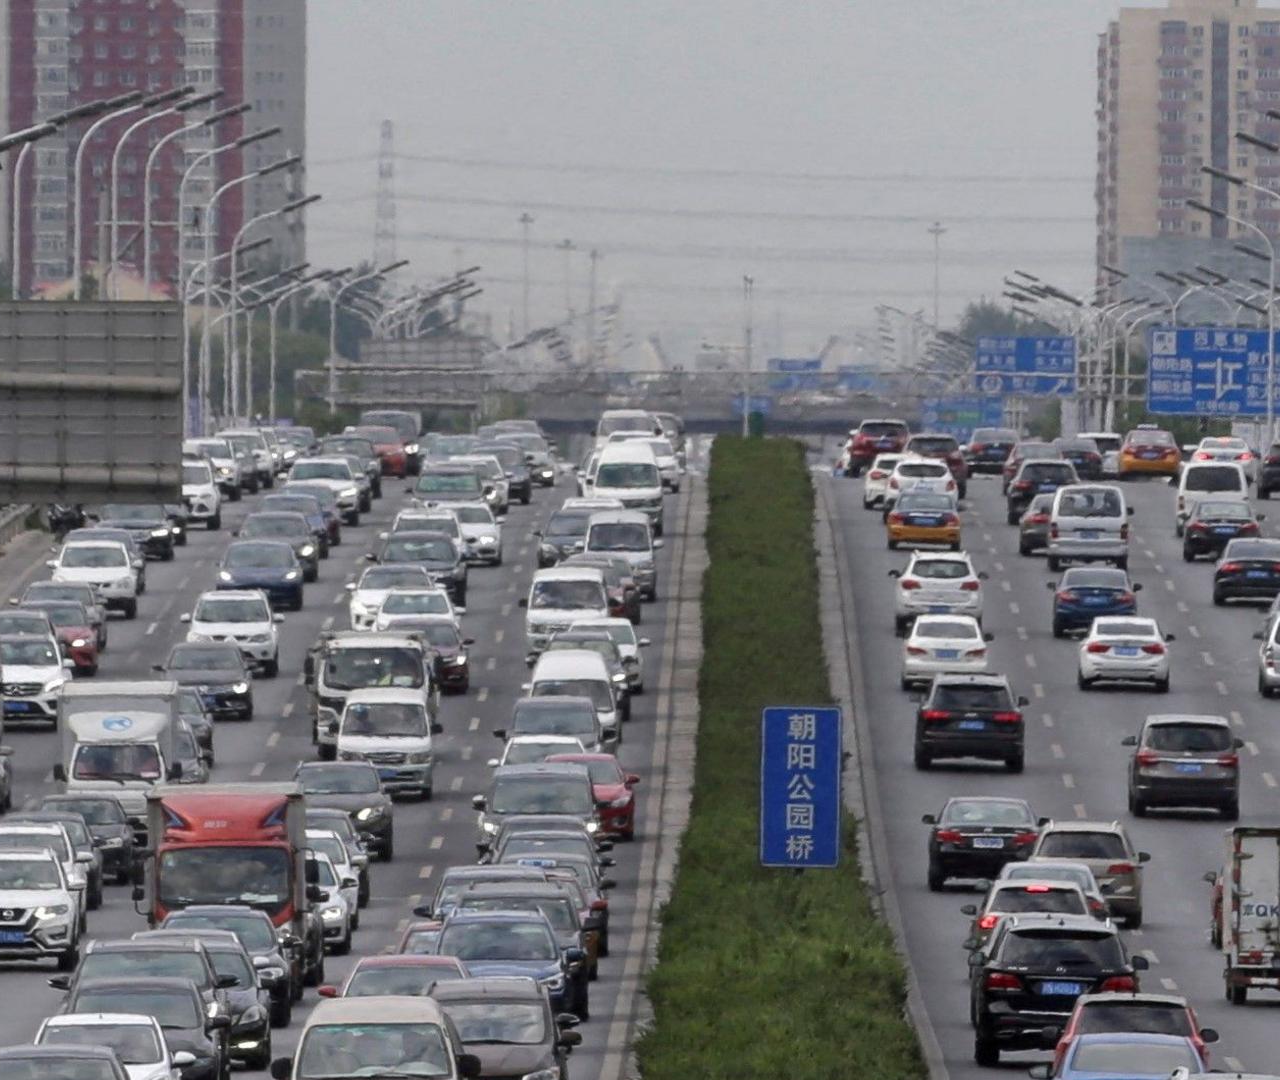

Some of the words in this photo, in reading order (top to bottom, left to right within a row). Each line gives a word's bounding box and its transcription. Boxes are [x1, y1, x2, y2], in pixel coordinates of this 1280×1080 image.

[786, 713, 816, 860] 朝阳公园桥
